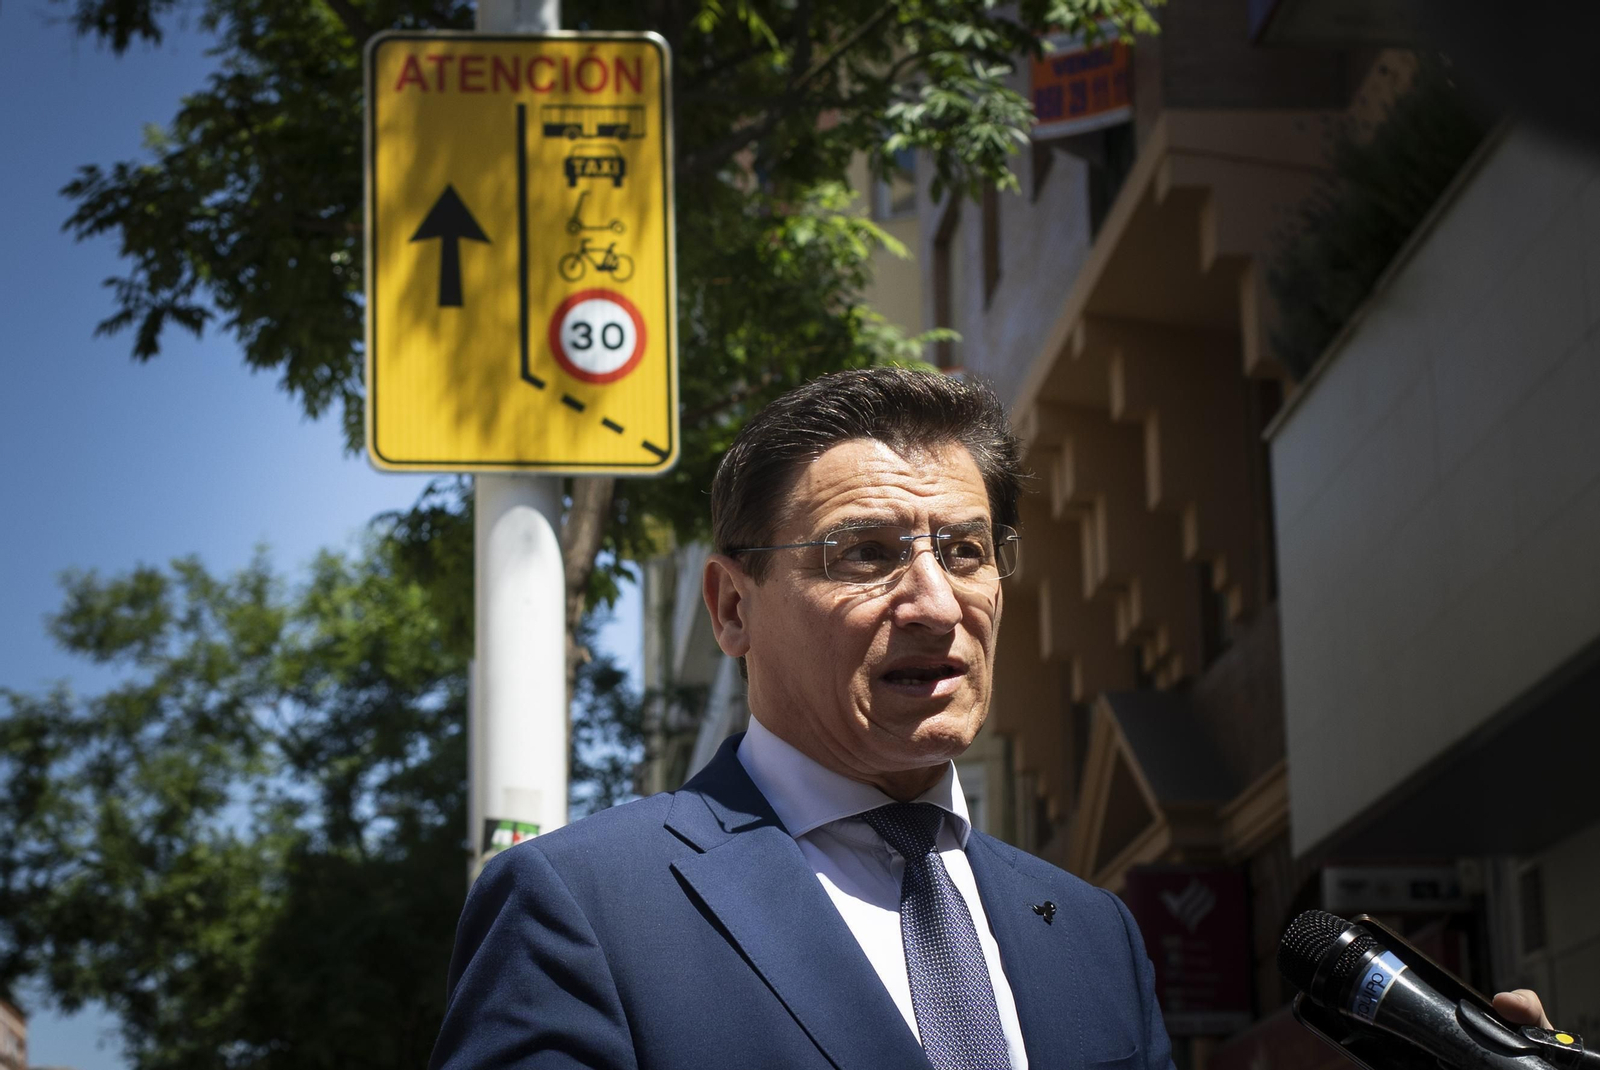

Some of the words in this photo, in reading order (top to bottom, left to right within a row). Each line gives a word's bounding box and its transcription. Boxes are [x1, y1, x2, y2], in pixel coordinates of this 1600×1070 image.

[395, 45, 643, 95] ATENCIÓN
[572, 159, 620, 174] TAXI
[571, 321, 624, 350] 30
